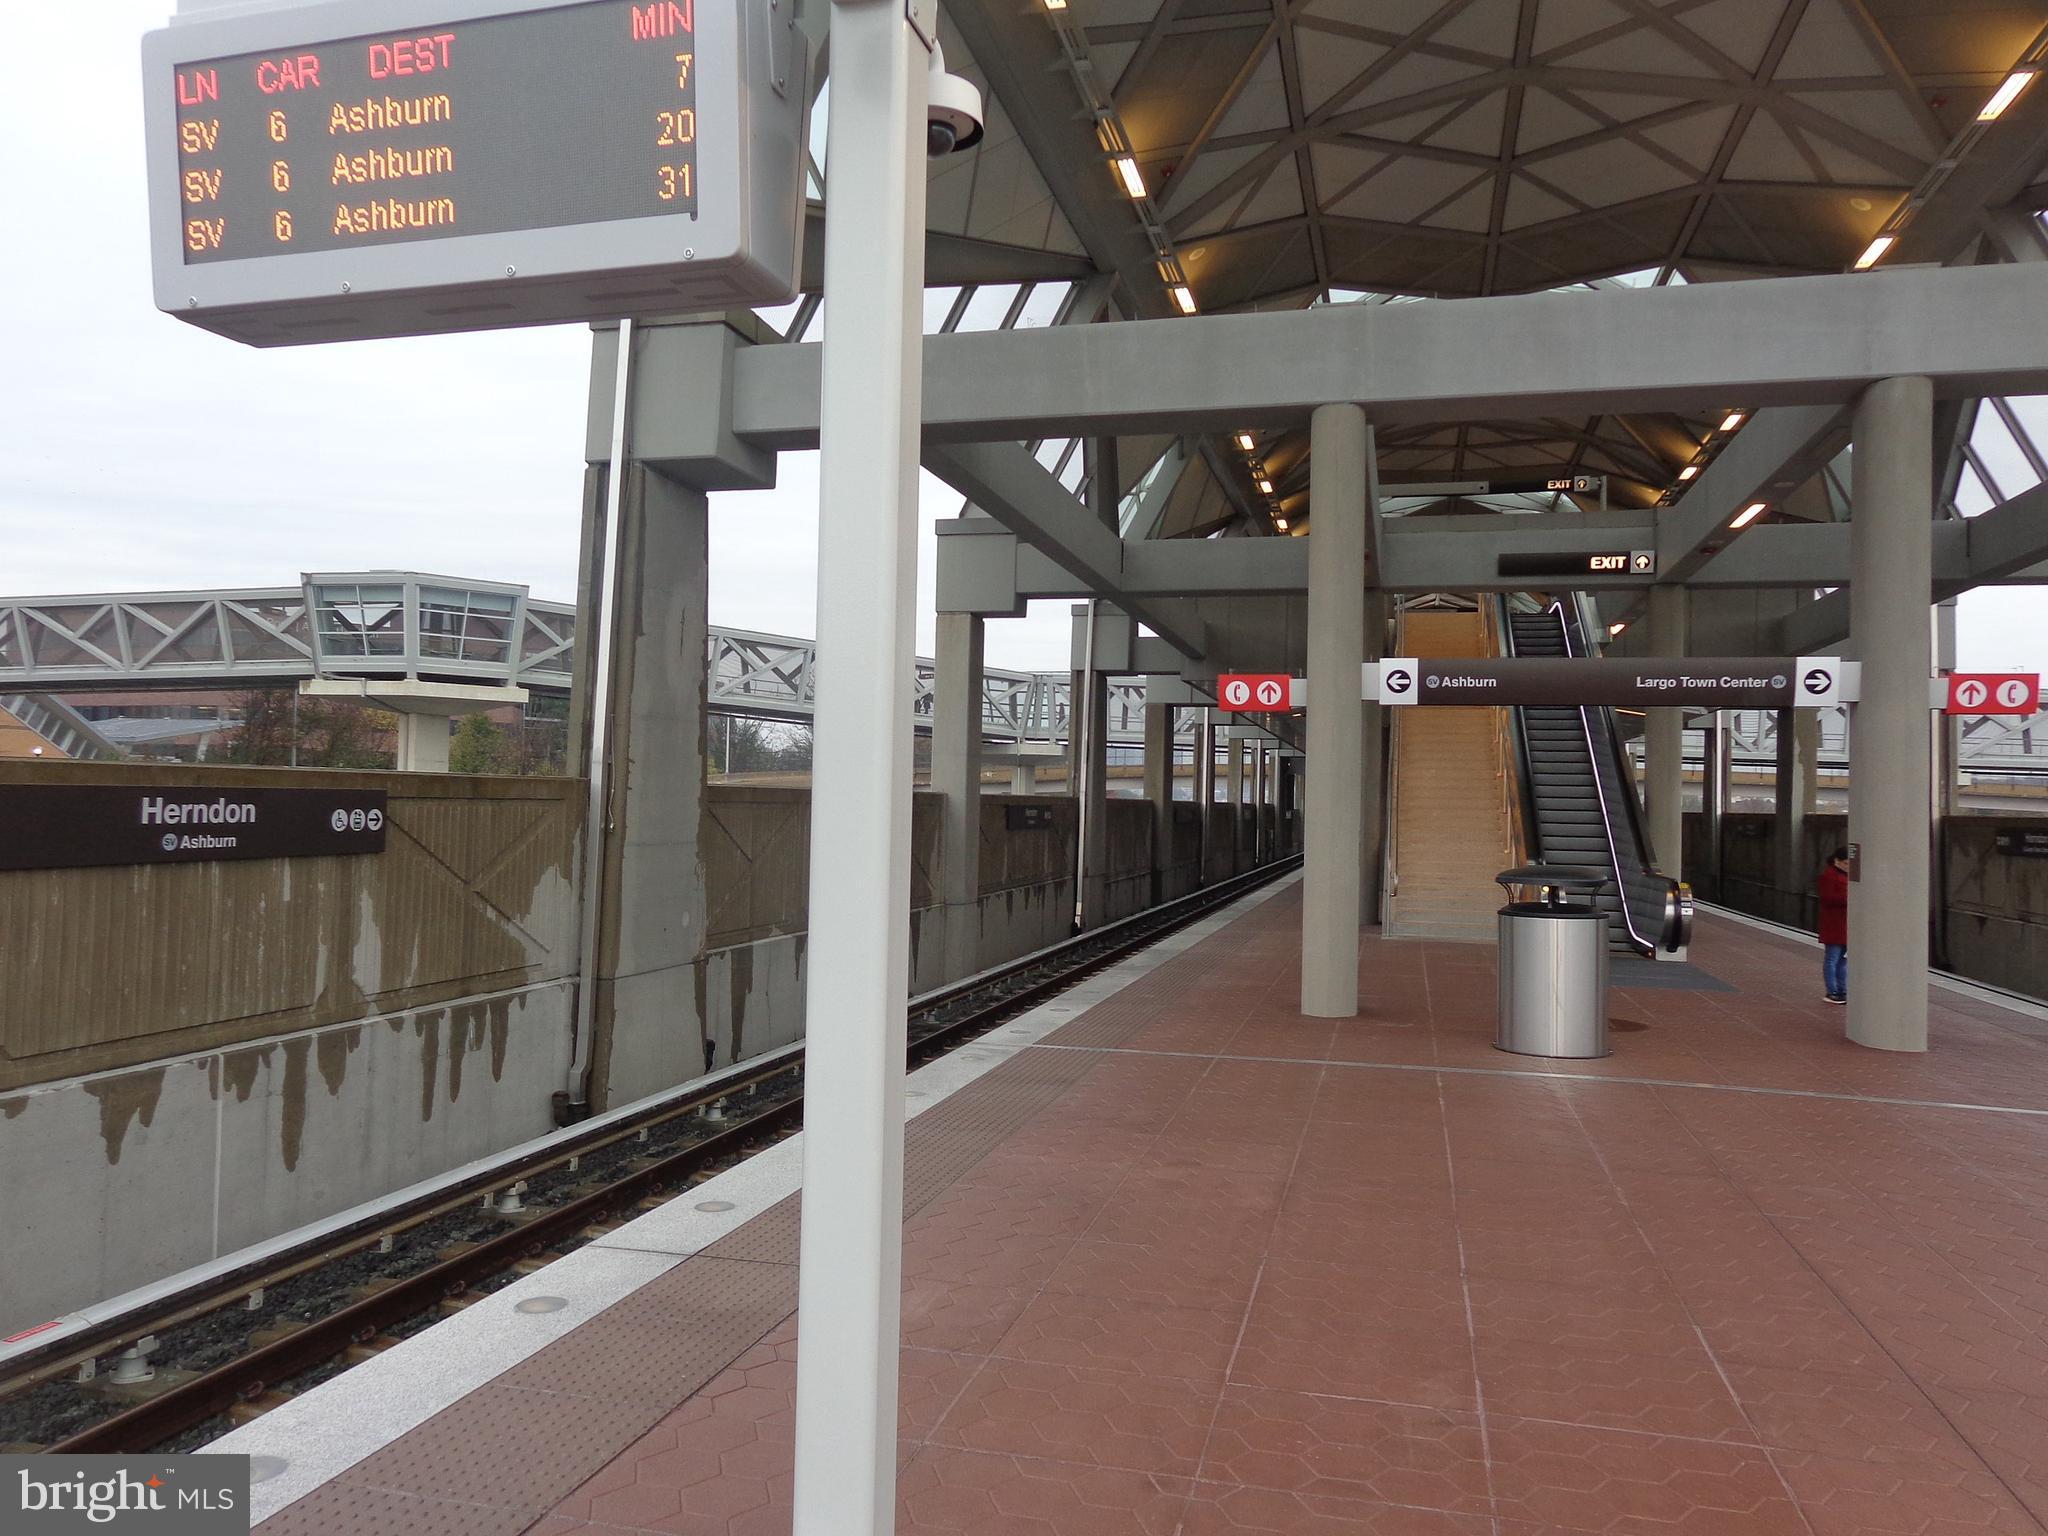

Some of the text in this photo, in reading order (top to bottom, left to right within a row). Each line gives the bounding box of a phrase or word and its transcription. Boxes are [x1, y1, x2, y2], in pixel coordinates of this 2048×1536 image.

[178, 0, 692, 105] LN CAR DEST MIN
[181, 53, 692, 153] SV 6 Ashburn 7
[184, 108, 694, 202] SV 6 Ashburn 20
[187, 163, 690, 251] SV 6 Ashburn 31
[1547, 479, 1572, 489] EXIT
[1590, 556, 1627, 570] EXIT
[1442, 676, 1497, 688] Ashburn
[1636, 676, 1677, 689] Largo
[1680, 676, 1717, 688] Town
[1720, 676, 1769, 688] Center
[141, 797, 256, 824] Herndon
[180, 835, 237, 849] Ashburn
